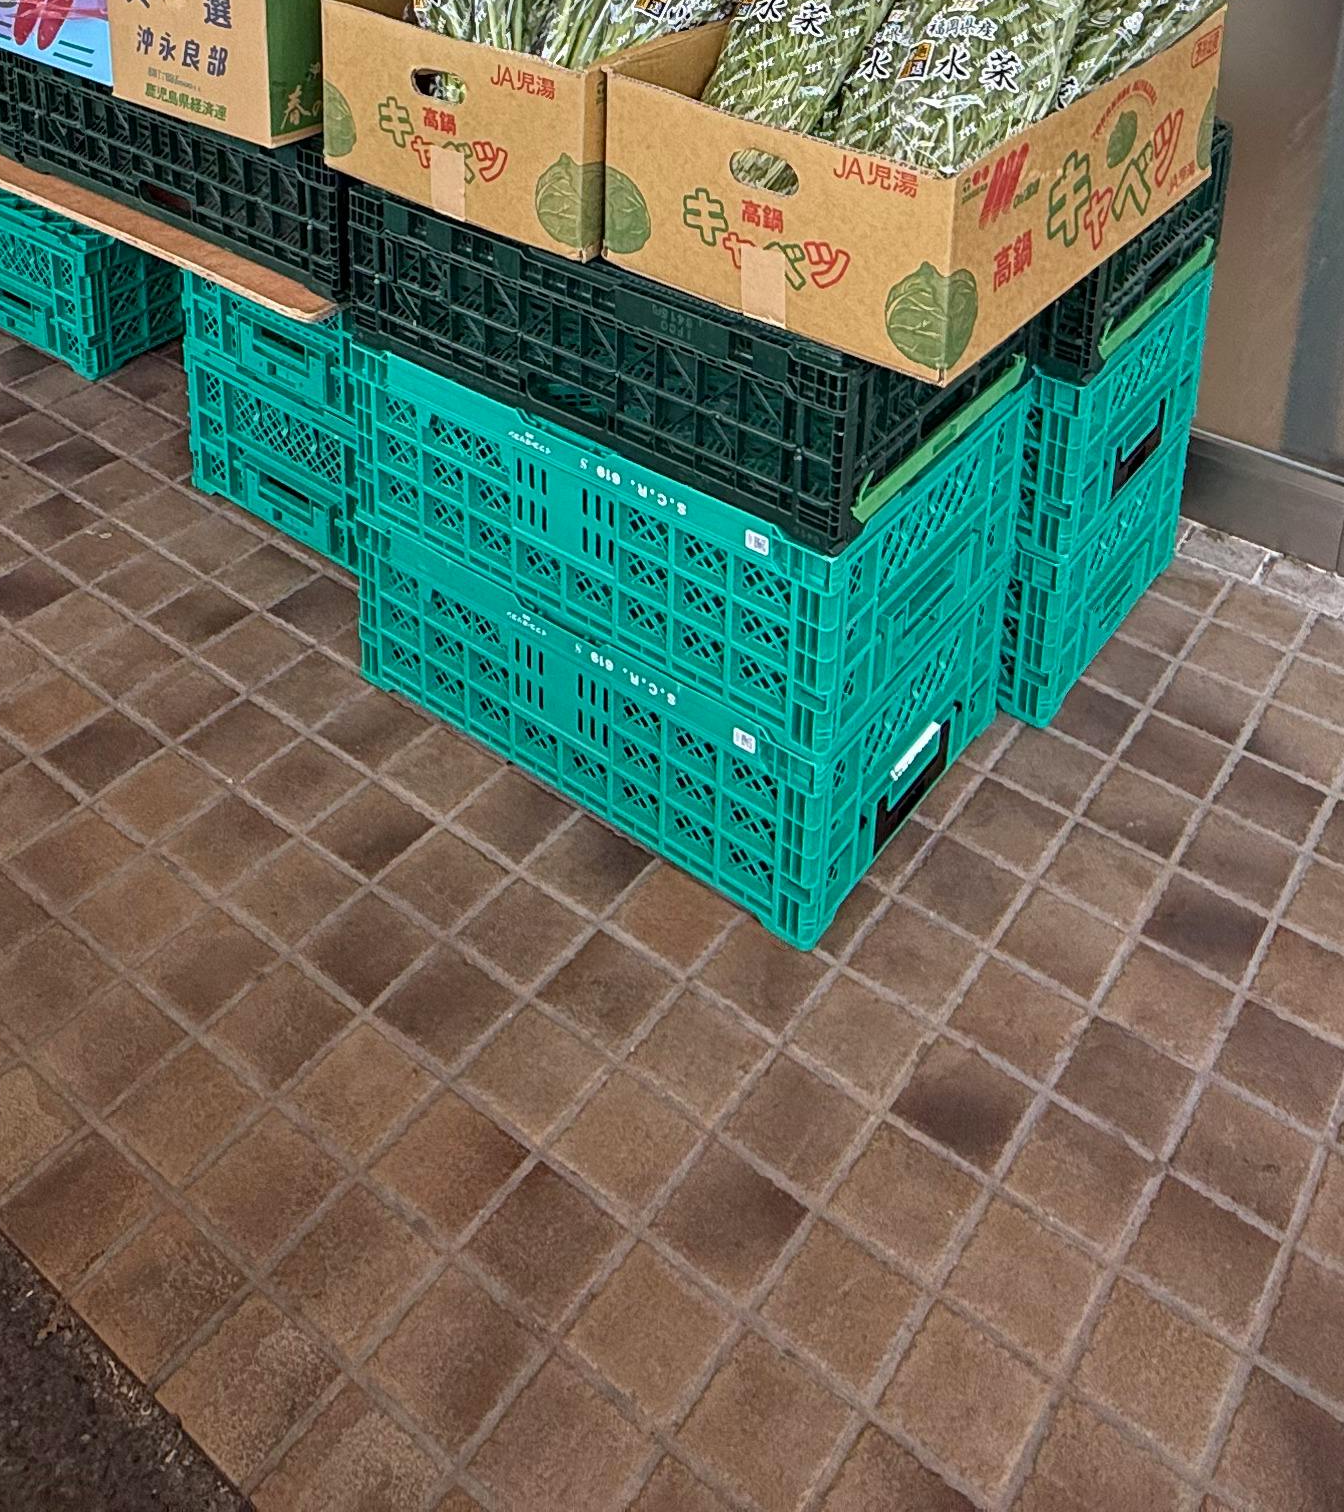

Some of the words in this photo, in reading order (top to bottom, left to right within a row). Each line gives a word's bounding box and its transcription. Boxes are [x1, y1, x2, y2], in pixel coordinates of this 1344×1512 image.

[928, 16, 998, 41] 福岡県産
[136, 24, 229, 78] 沖永良部
[855, 47, 892, 82] 水
[930, 44, 1023, 94] 水菜
[144, 81, 228, 122] 鹿児島県経済連
[490, 63, 556, 101] JA児湯
[422, 106, 457, 136] 高鍋
[832, 154, 919, 200] JA児湯
[1046, 107, 1184, 249] キャベツ
[741, 199, 785, 234] 高鍋
[992, 229, 1033, 292] 高鍋
